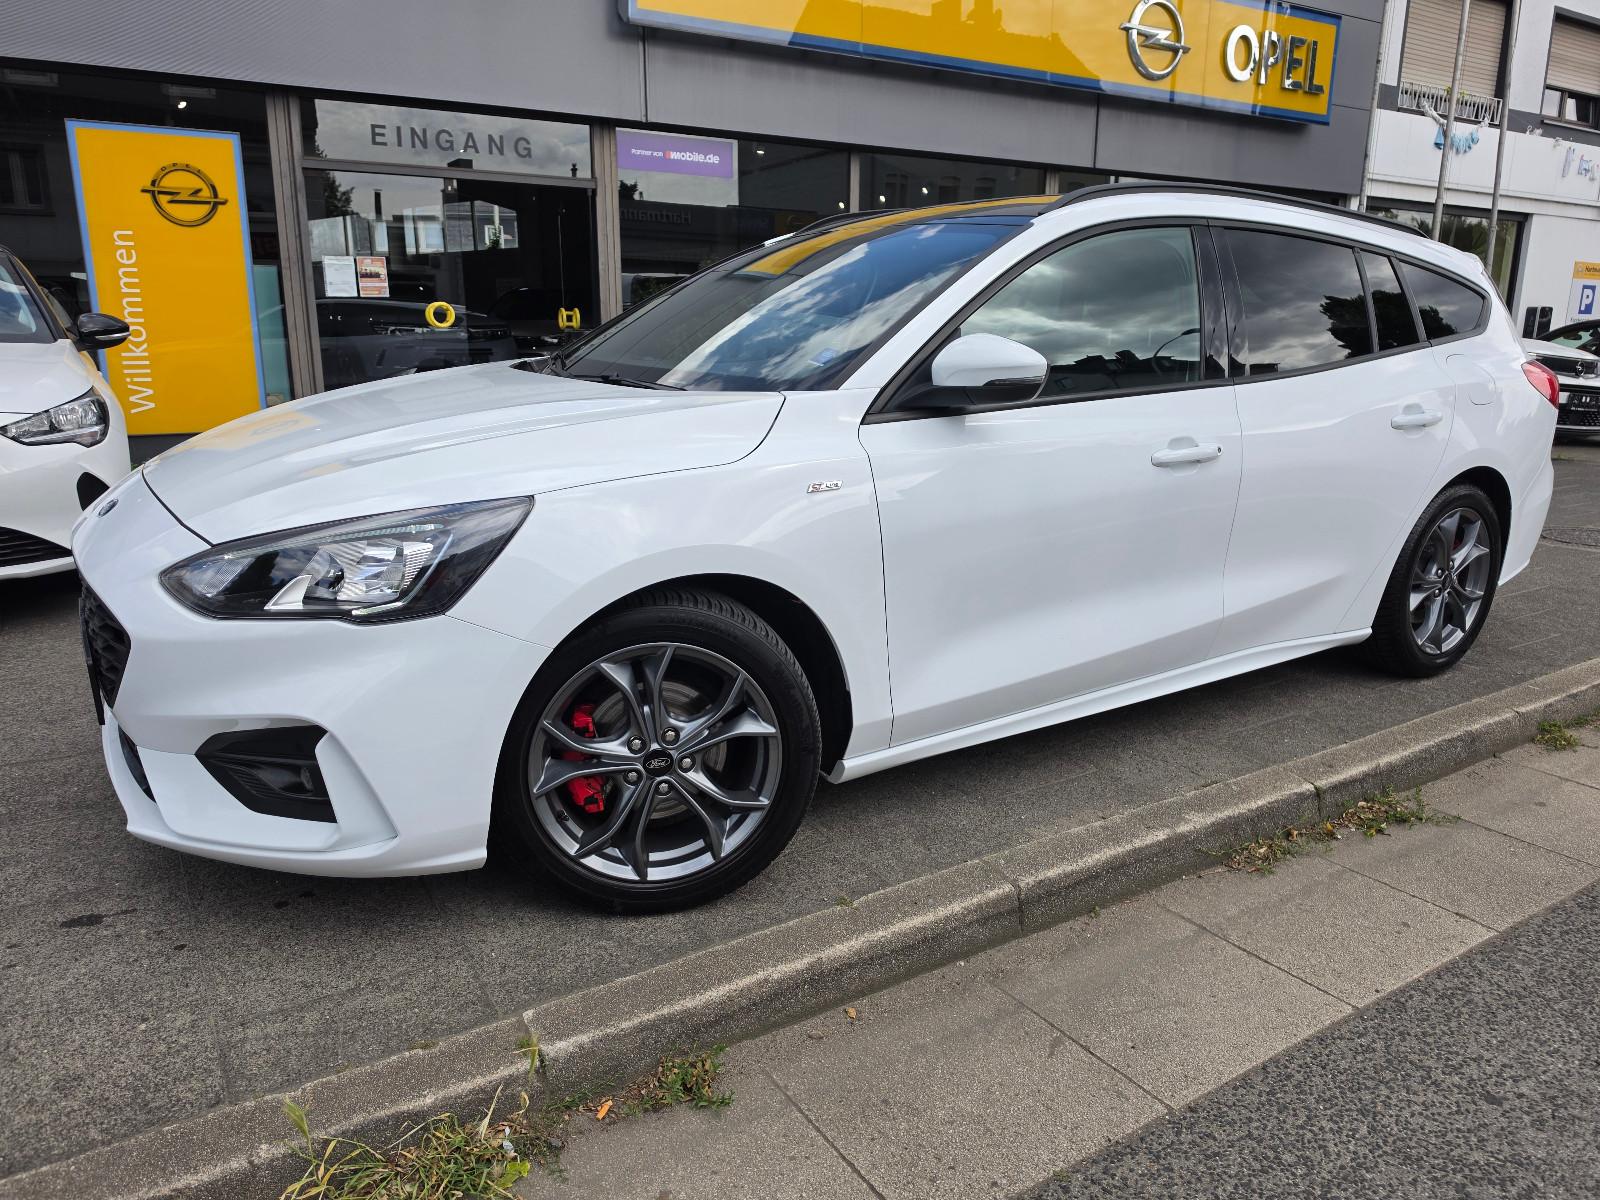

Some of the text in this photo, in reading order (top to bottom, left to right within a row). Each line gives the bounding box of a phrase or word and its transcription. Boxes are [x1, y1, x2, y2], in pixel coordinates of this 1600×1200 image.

[1225, 24, 1325, 94] OPEL
[370, 123, 533, 159] EINGANG
[631, 148, 653, 157] Partner
[670, 151, 720, 164] mobile.de
[113, 229, 156, 414] Willkommen
